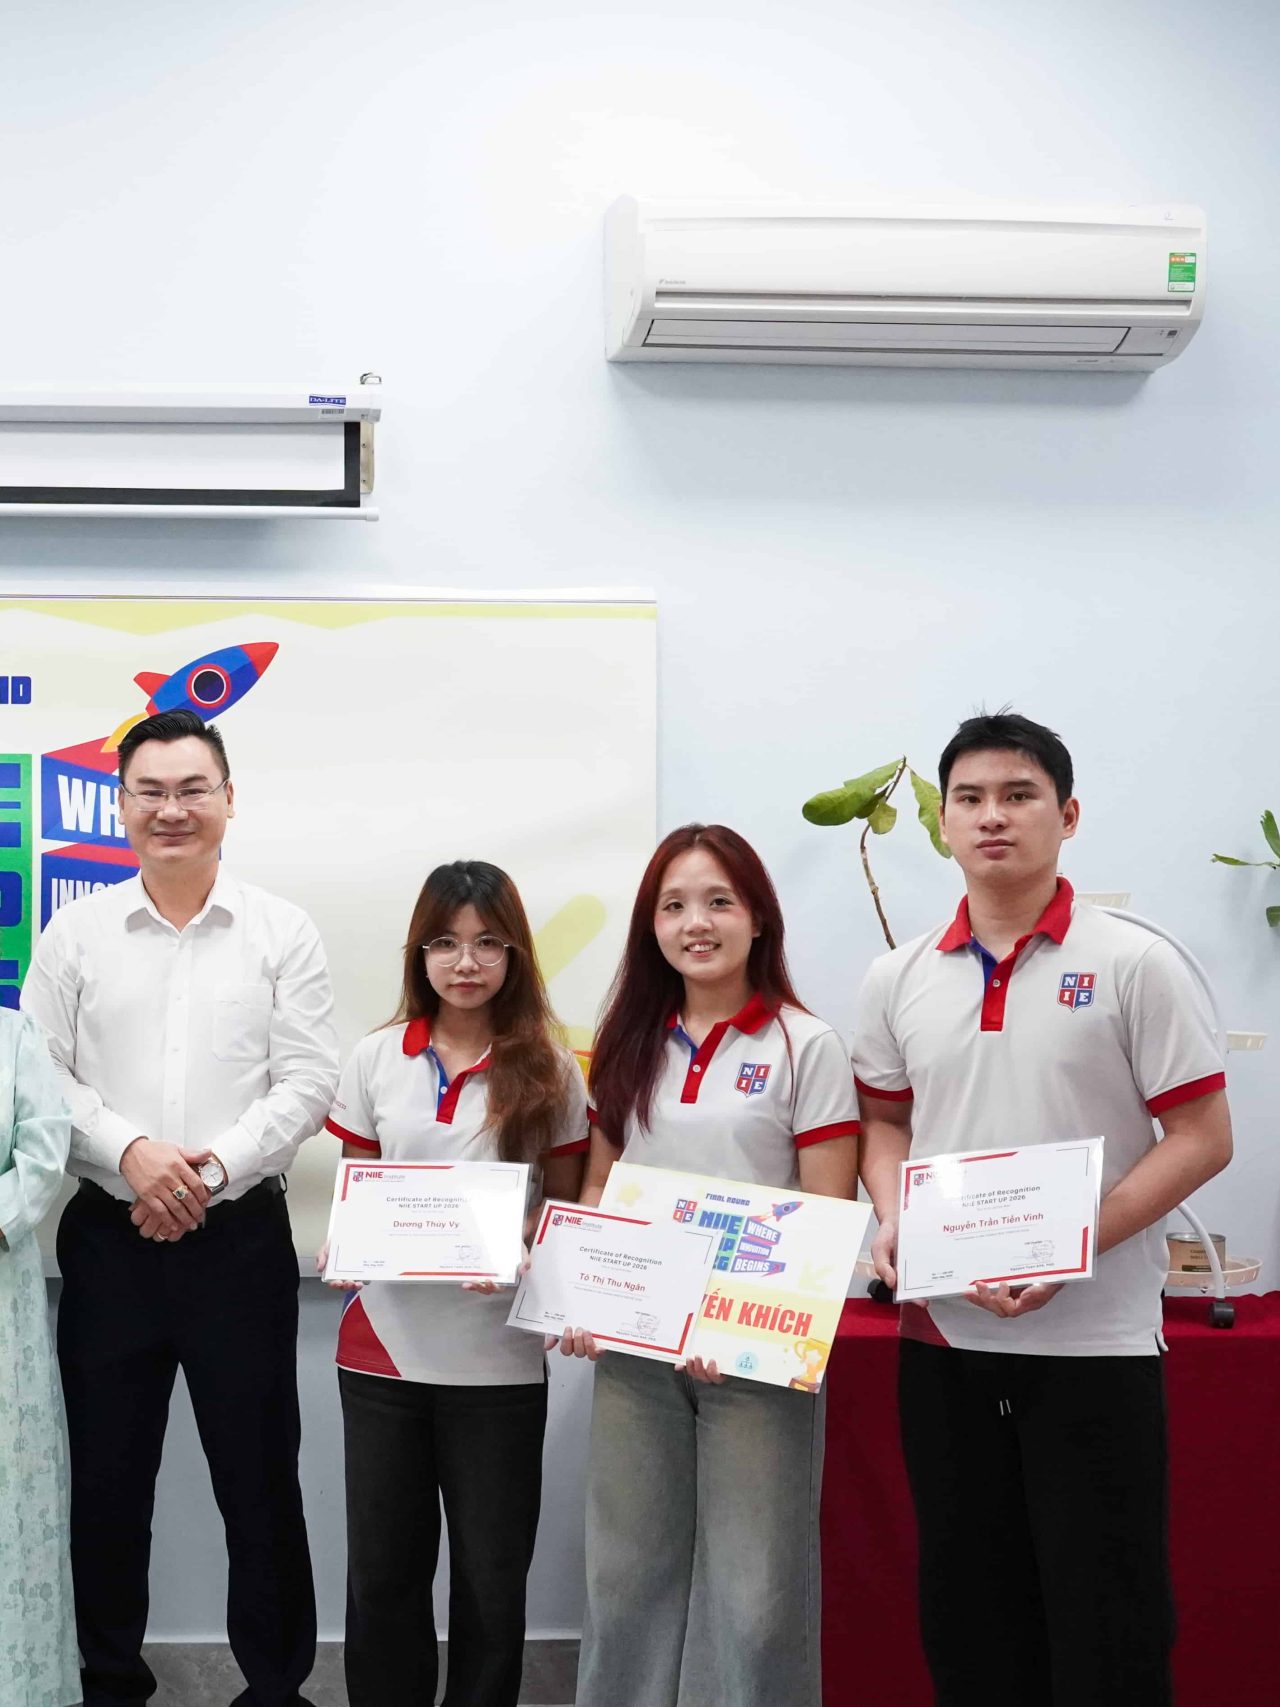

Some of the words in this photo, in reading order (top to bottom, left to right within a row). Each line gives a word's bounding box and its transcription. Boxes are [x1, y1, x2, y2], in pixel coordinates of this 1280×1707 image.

[365, 1171, 384, 1179] NIIE
[997, 1185, 1041, 1196] Recognition
[564, 1215, 583, 1226] NIIE
[698, 1210, 743, 1235] NIIE
[1023, 1213, 1044, 1221] Vinh
[393, 1220, 423, 1230] Dương
[449, 1220, 460, 1229] Vy
[746, 1221, 778, 1243] WHERE
[579, 1246, 613, 1257] Certificate
[623, 1253, 662, 1266] Recognition
[603, 1257, 621, 1265] START
[632, 1262, 648, 1270] 2026
[734, 1259, 770, 1272] BEGINS
[592, 1275, 605, 1285] Thị
[607, 1278, 622, 1287] Thu
[737, 1303, 813, 1337] KHÍCH
